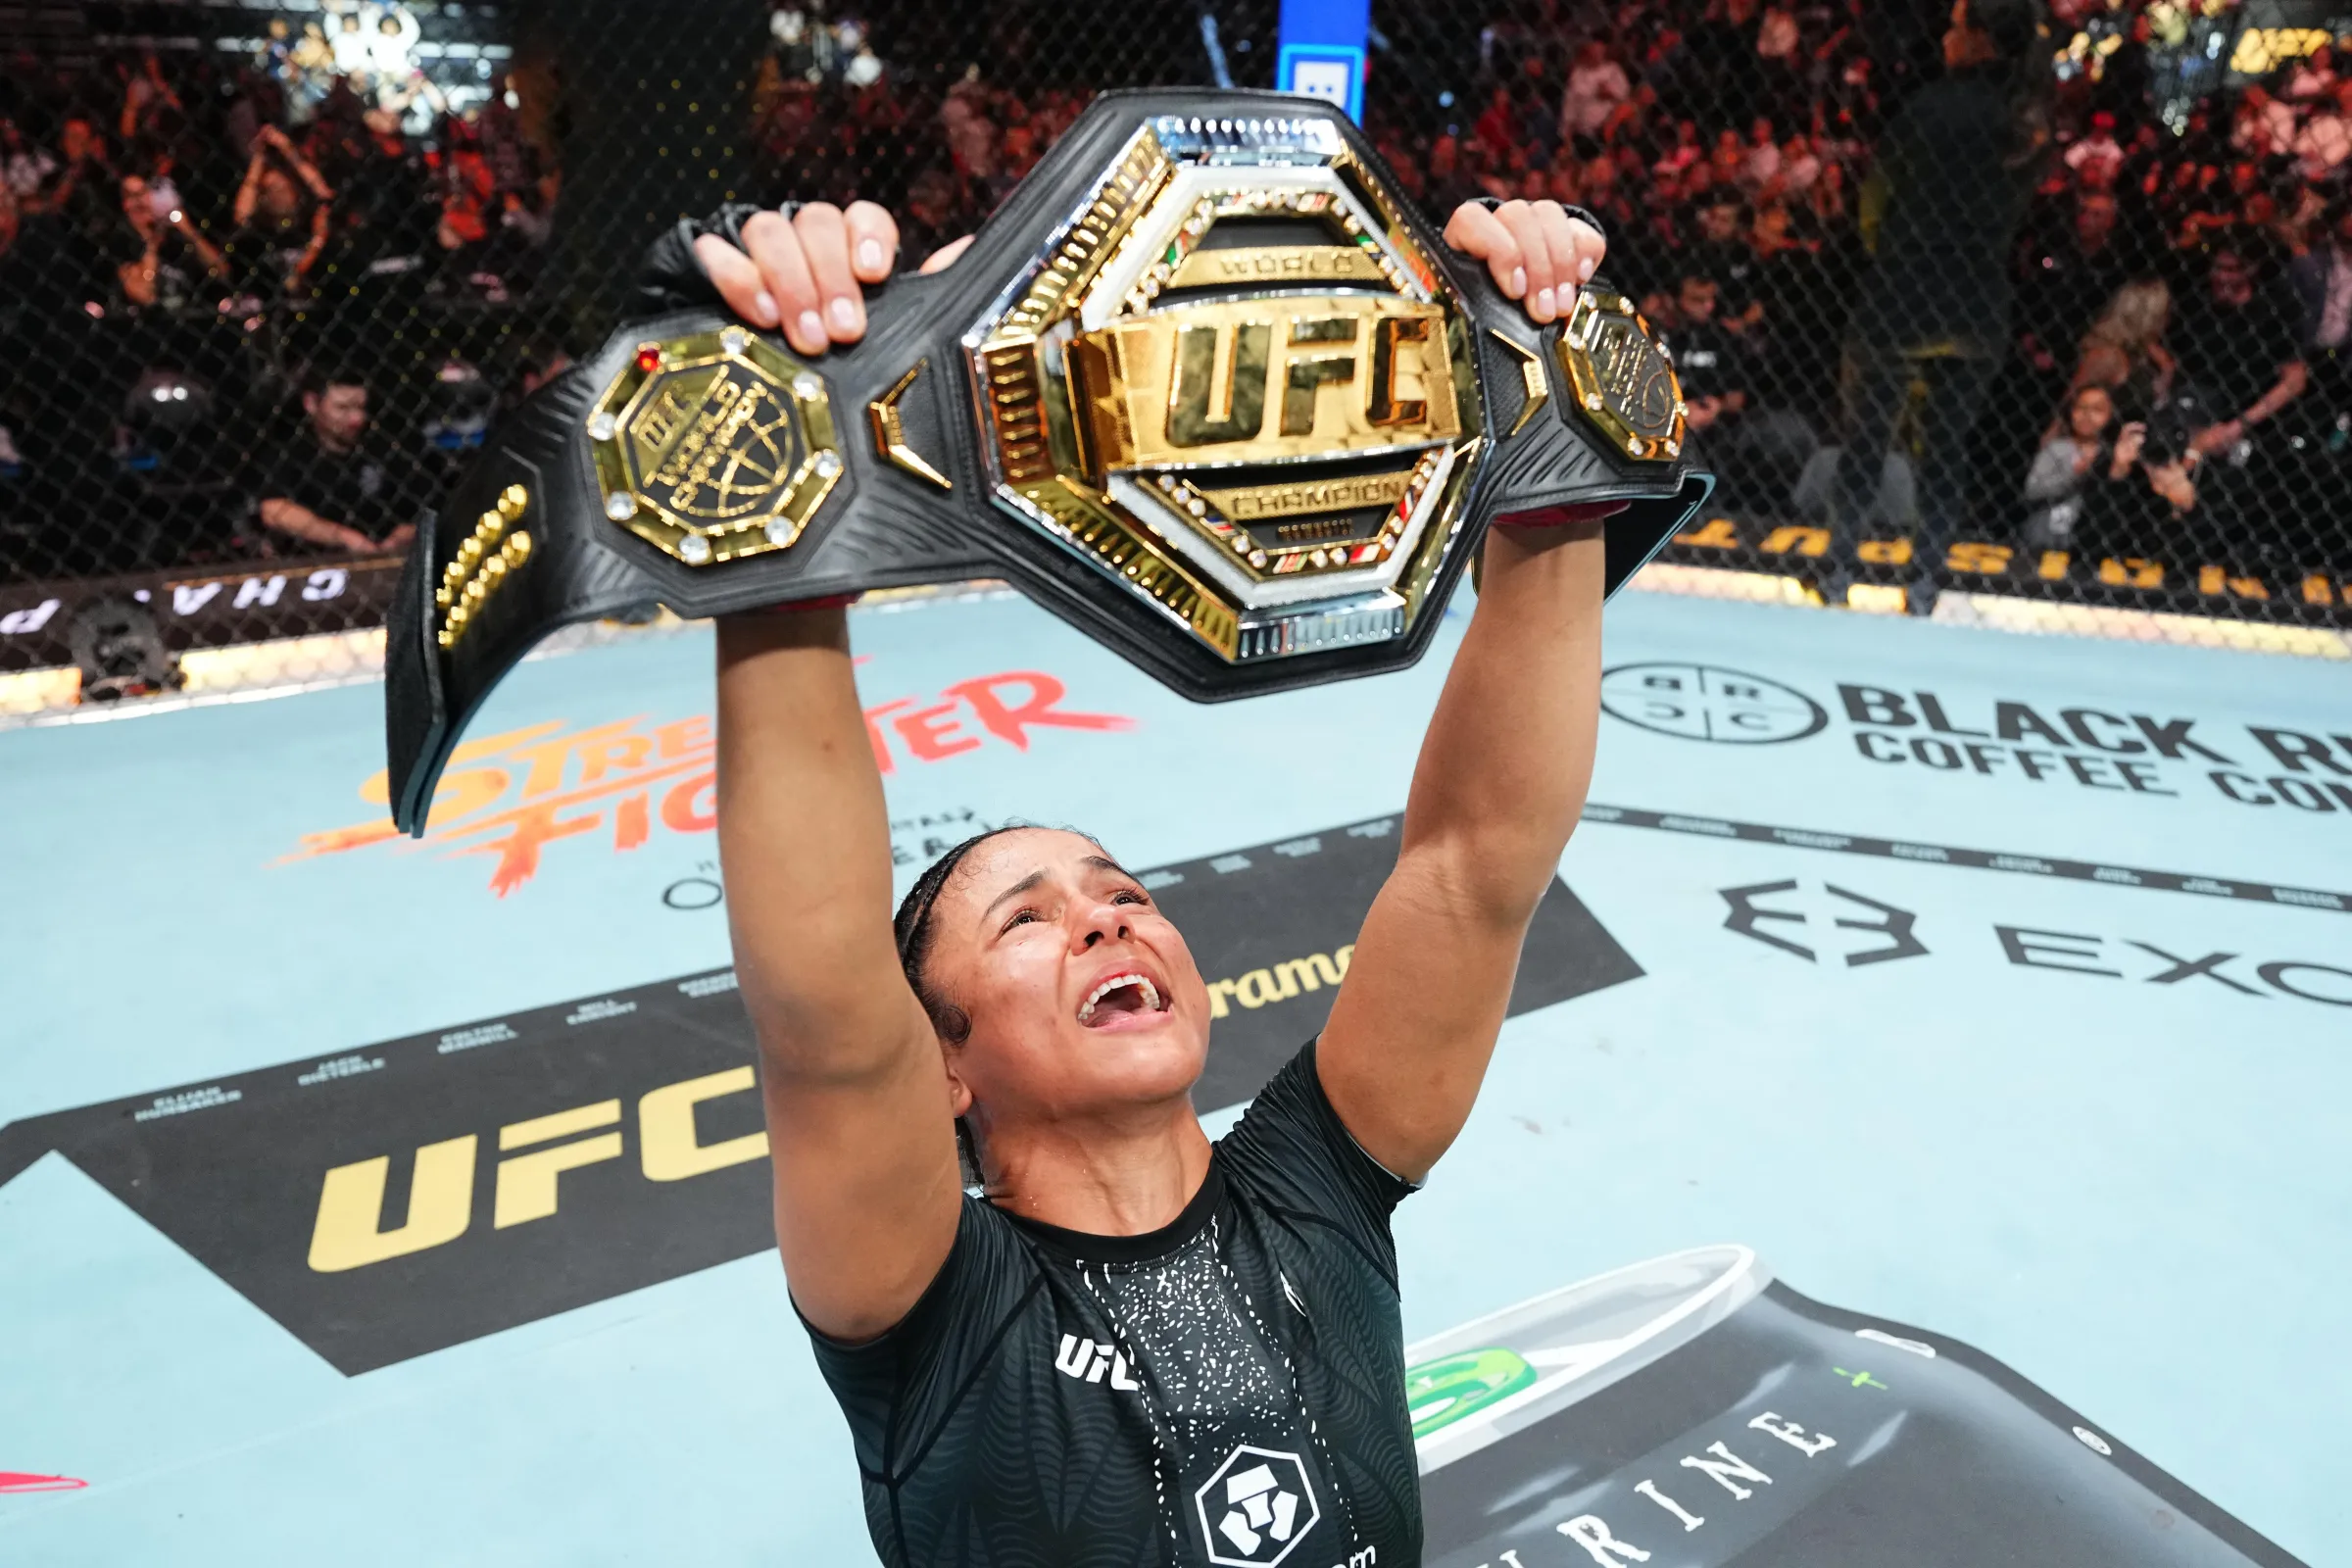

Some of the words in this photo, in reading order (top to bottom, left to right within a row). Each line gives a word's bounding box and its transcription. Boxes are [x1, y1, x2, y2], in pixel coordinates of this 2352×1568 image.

[1221, 252, 1354, 275] WORLD
[1163, 316, 1429, 449] UFC
[1232, 480, 1400, 517] CHAMPION
[1836, 683, 2241, 767] BLACK
[1854, 731, 2180, 798] COFFEE
[434, 669, 1140, 900] FIGTER
[307, 1064, 770, 1273] UFC
